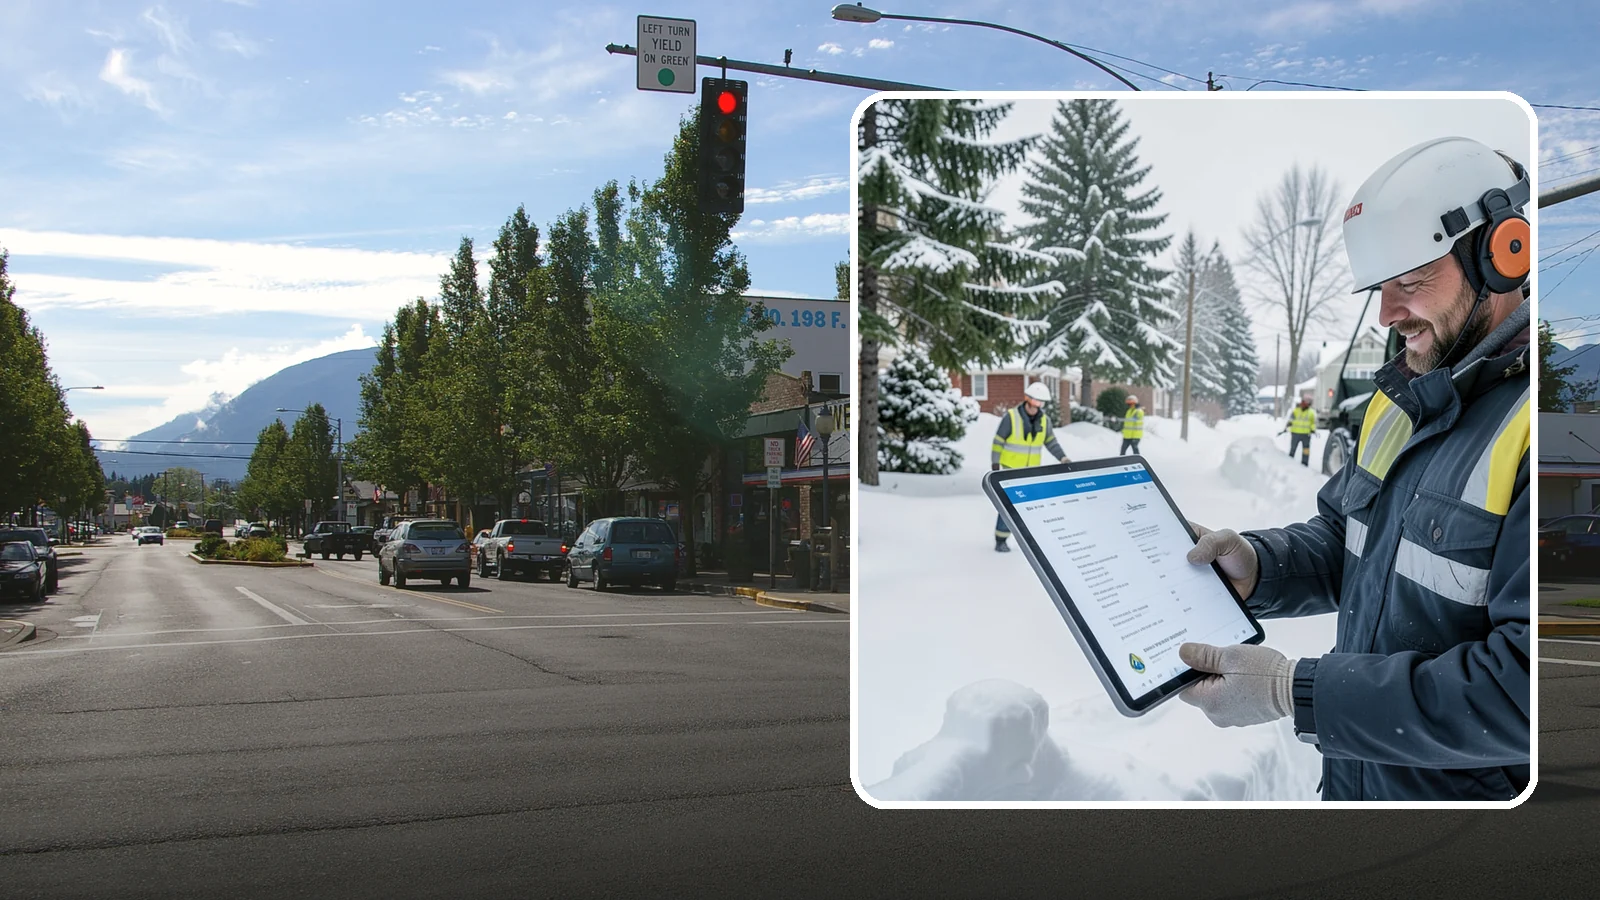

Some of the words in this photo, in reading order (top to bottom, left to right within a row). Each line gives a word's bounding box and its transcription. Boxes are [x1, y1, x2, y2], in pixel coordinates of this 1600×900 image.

[643, 24, 663, 34] LEFT
[668, 25, 690, 36] TURN
[652, 38, 681, 51] YIELD
[644, 53, 656, 63] ON
[661, 54, 688, 66] GREEN
[791, 309, 826, 328] 198
[831, 311, 847, 329] F.
